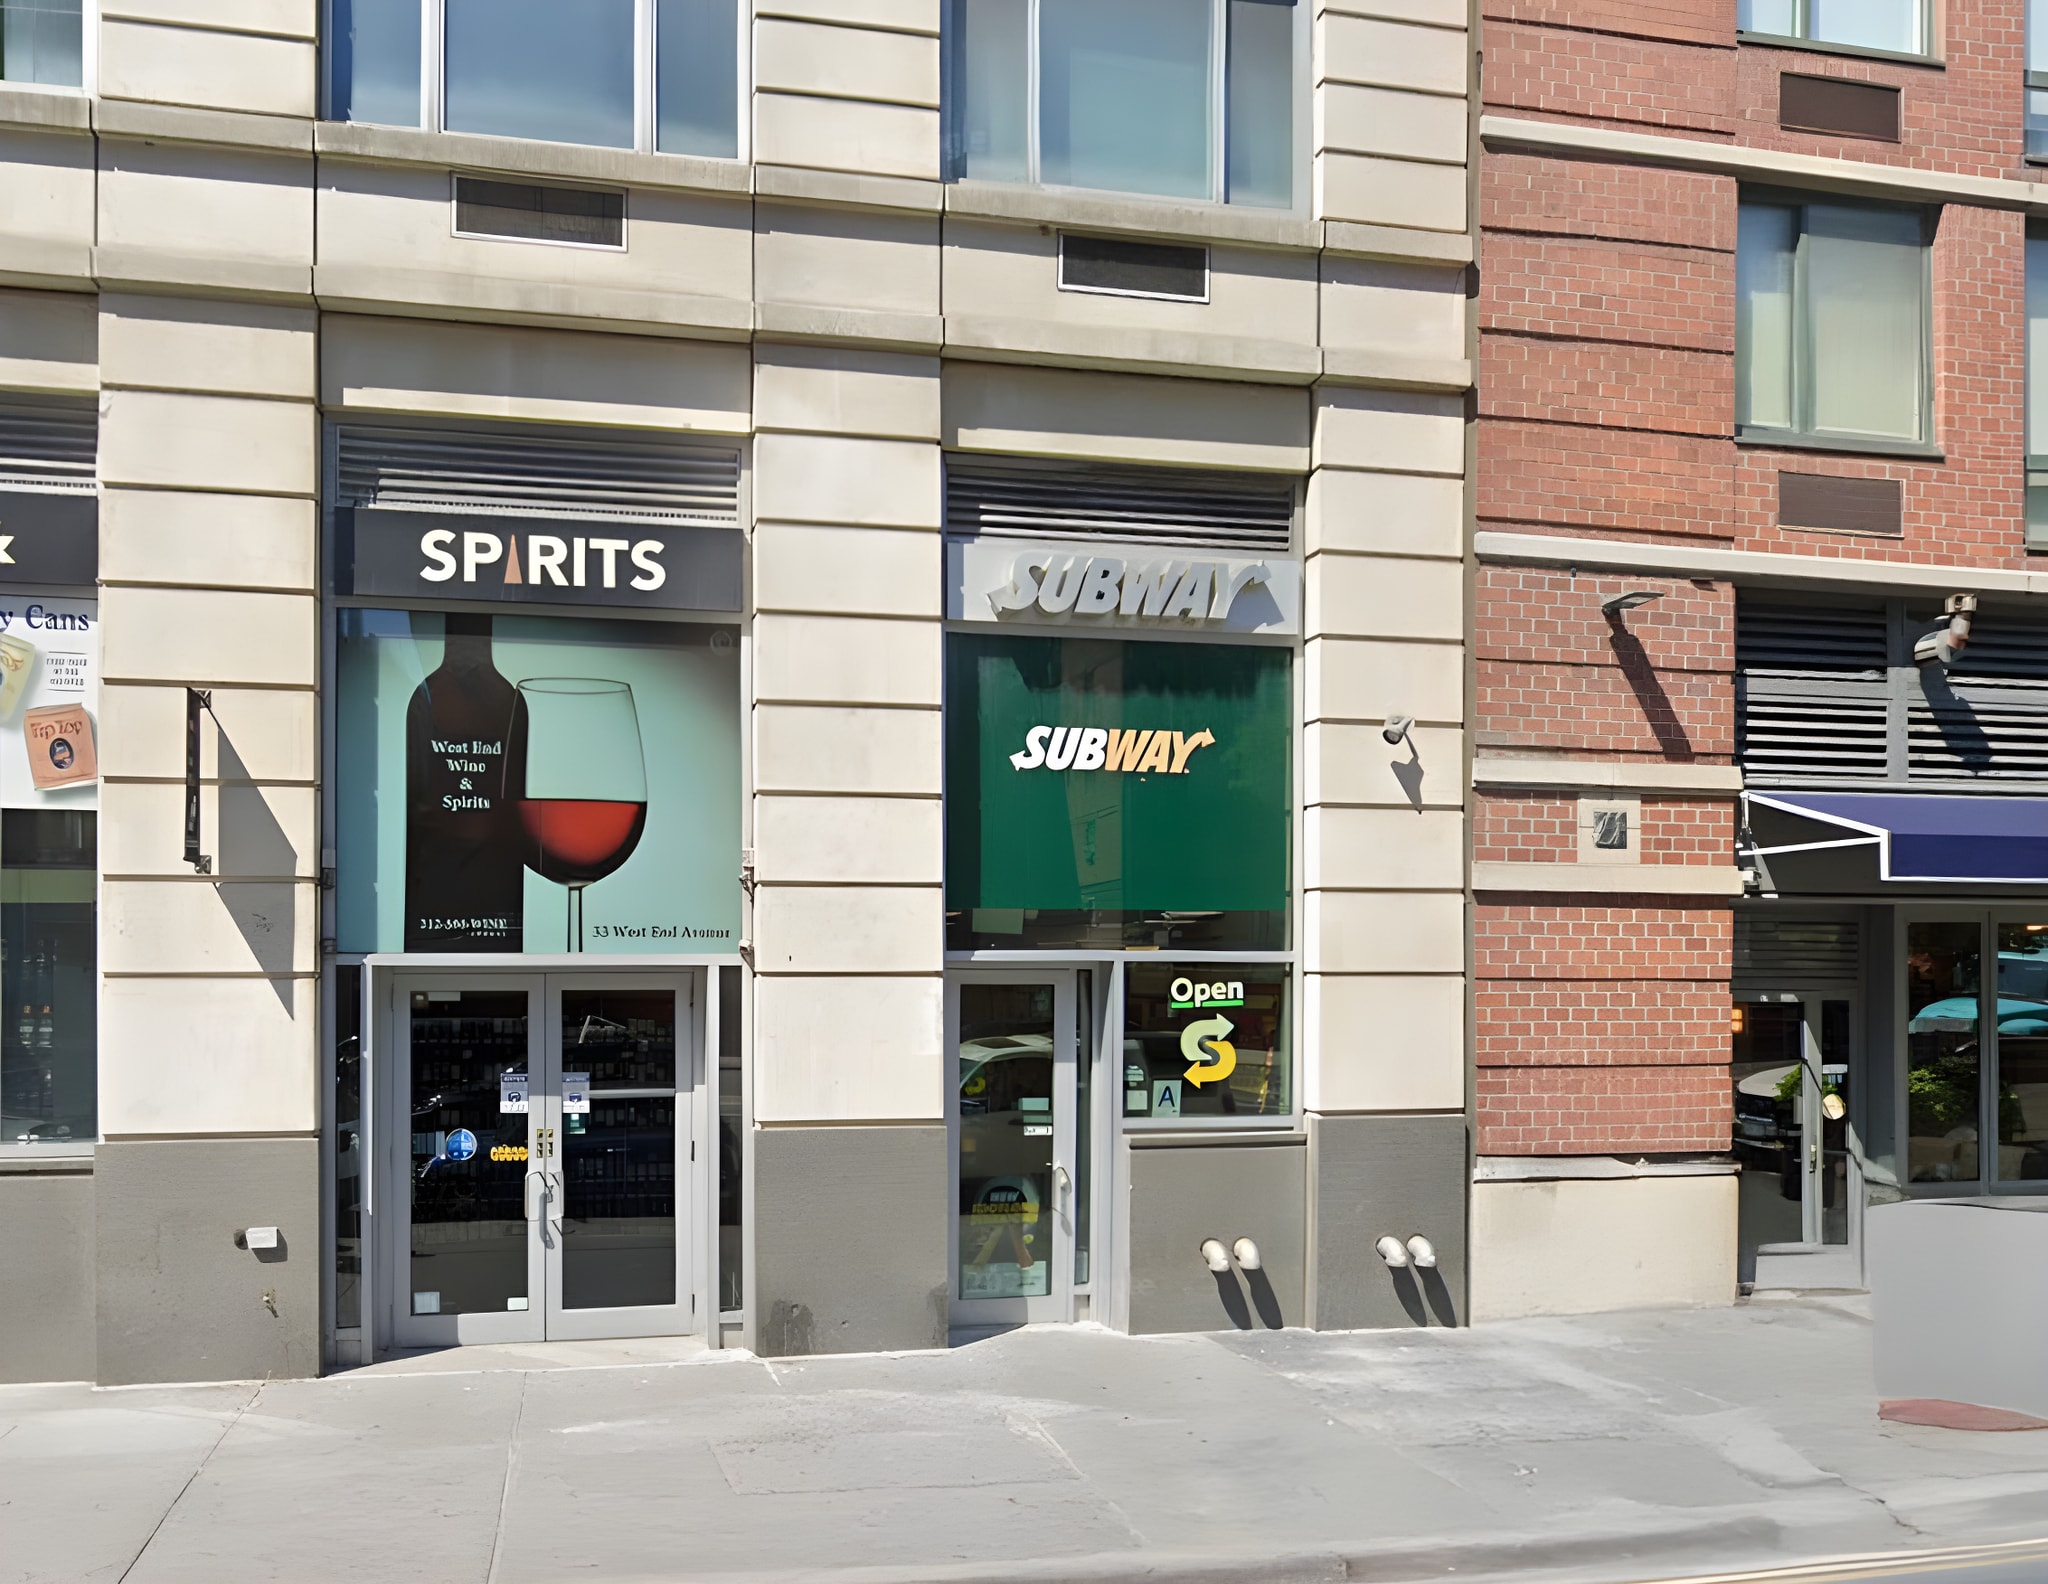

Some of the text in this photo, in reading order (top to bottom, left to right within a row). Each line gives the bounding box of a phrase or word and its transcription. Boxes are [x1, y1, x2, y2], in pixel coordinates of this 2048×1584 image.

[419, 529, 667, 592] SPIRITS
[987, 550, 1272, 621] SUBWAY
[25, 604, 90, 631] Cans
[1009, 724, 1216, 775] SUBWAY
[459, 777, 473, 790] &
[1170, 976, 1244, 1008] Open
[1157, 1085, 1176, 1108] A
